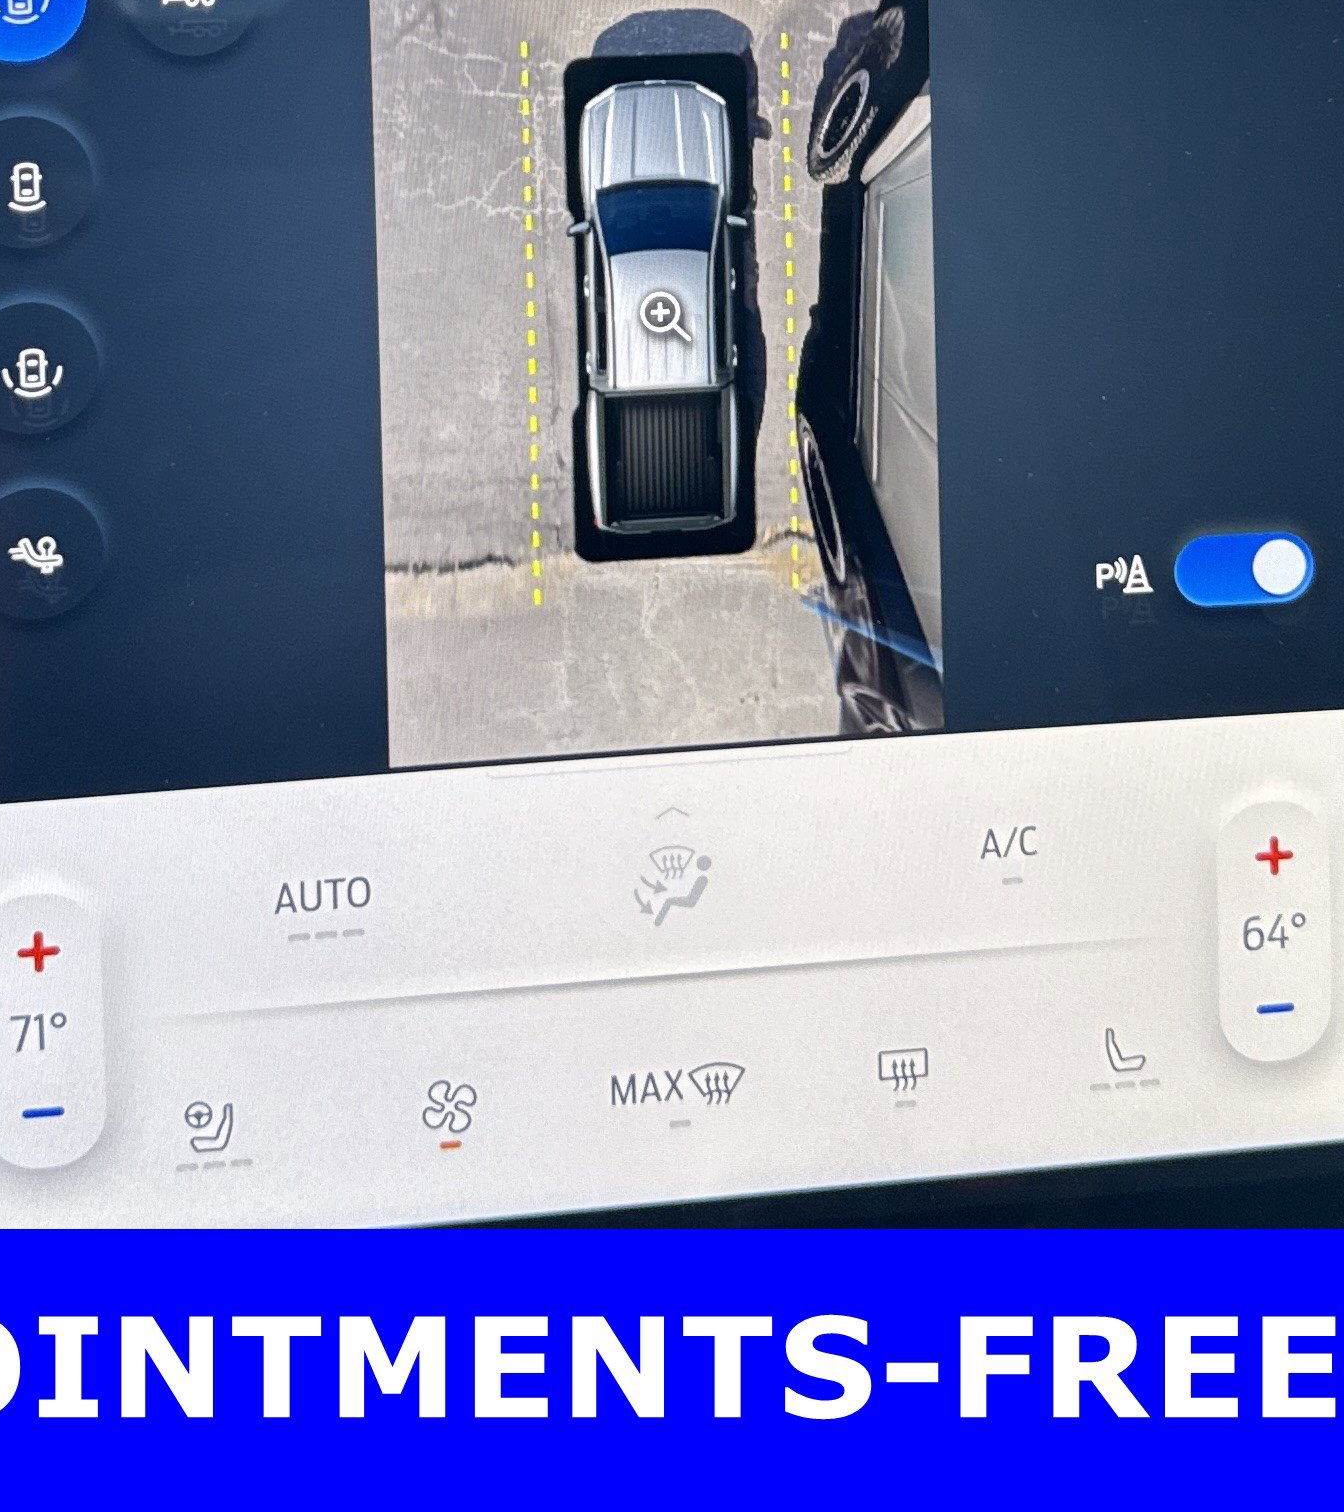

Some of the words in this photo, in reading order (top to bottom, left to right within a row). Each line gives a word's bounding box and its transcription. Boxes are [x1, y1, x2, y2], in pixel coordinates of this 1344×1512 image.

[980, 825, 1038, 860] A/C
[274, 876, 371, 915] AUTO
[1242, 912, 1306, 952] 64°
[10, 1012, 67, 1053] 71°
[611, 1069, 684, 1106] MAX
